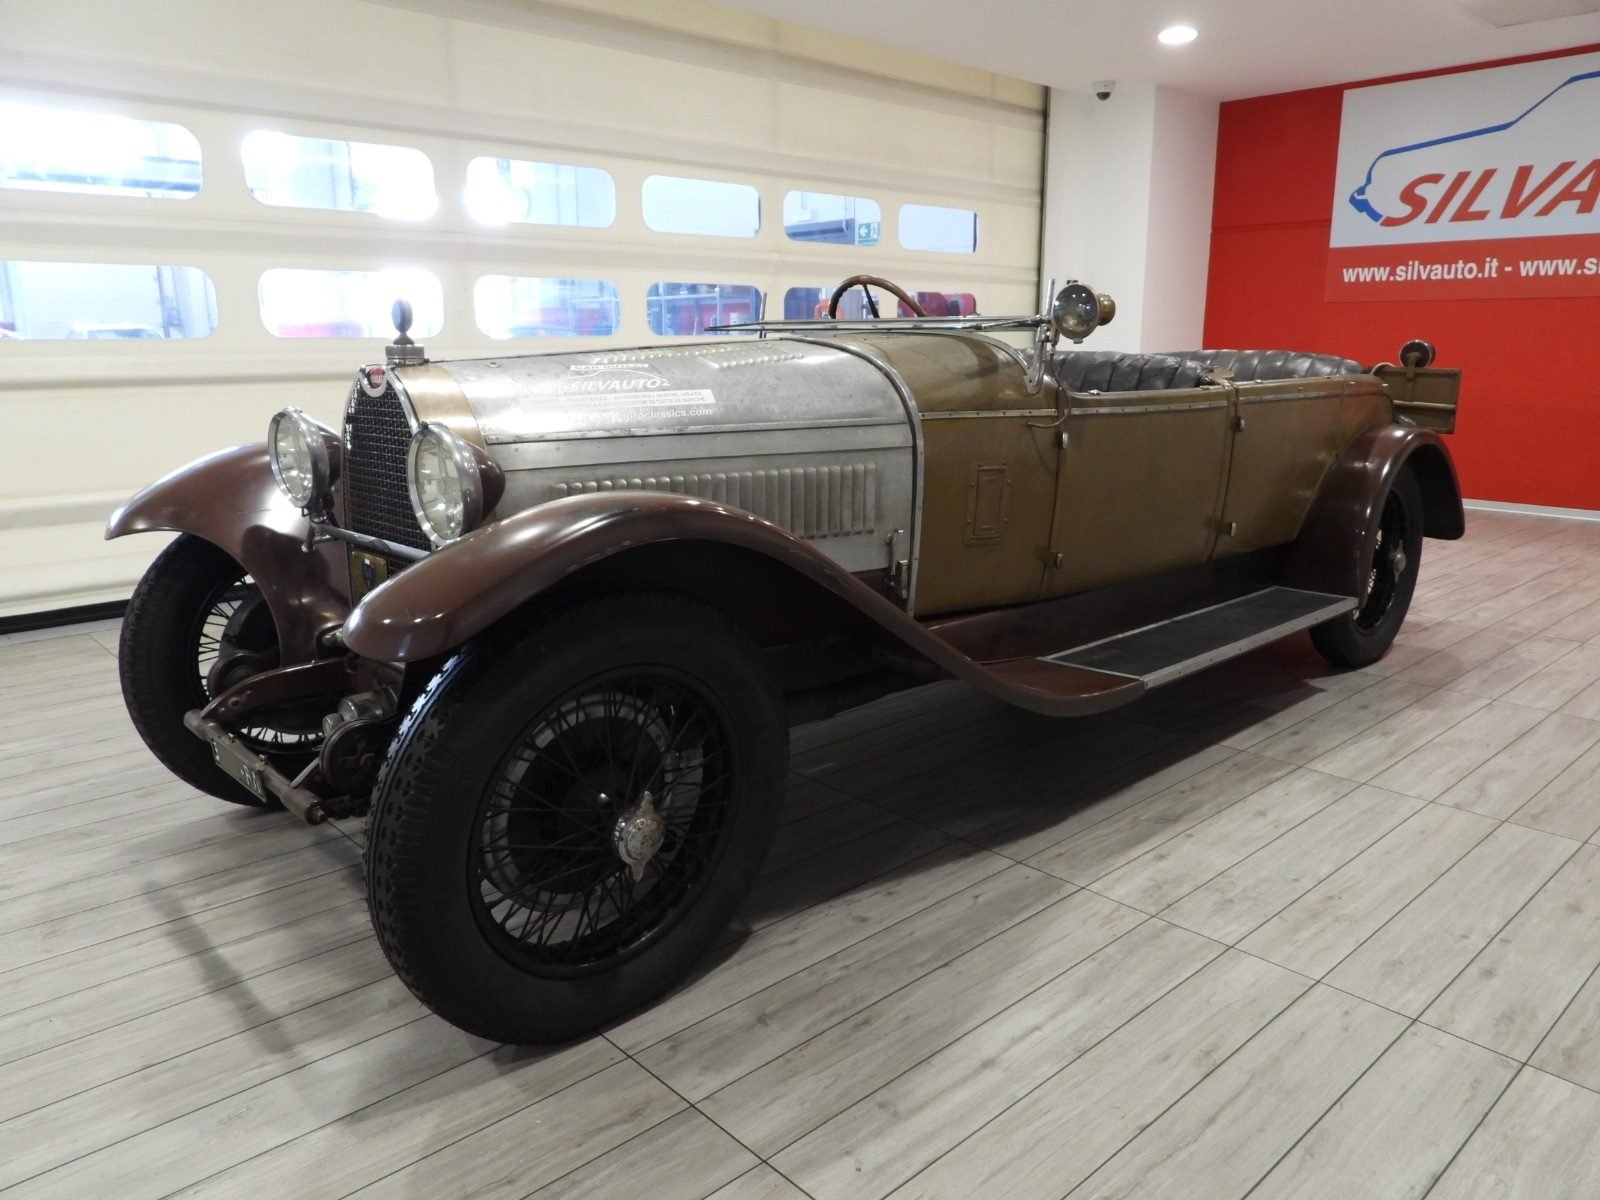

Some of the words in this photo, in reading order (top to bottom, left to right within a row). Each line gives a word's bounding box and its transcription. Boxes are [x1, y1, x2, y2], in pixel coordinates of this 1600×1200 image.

[1379, 159, 1600, 227] SILVA
[1342, 257, 1499, 283] www.silvauto.it
[1519, 257, 1600, 278] www.s
[568, 379, 661, 393] SILVAUTO
